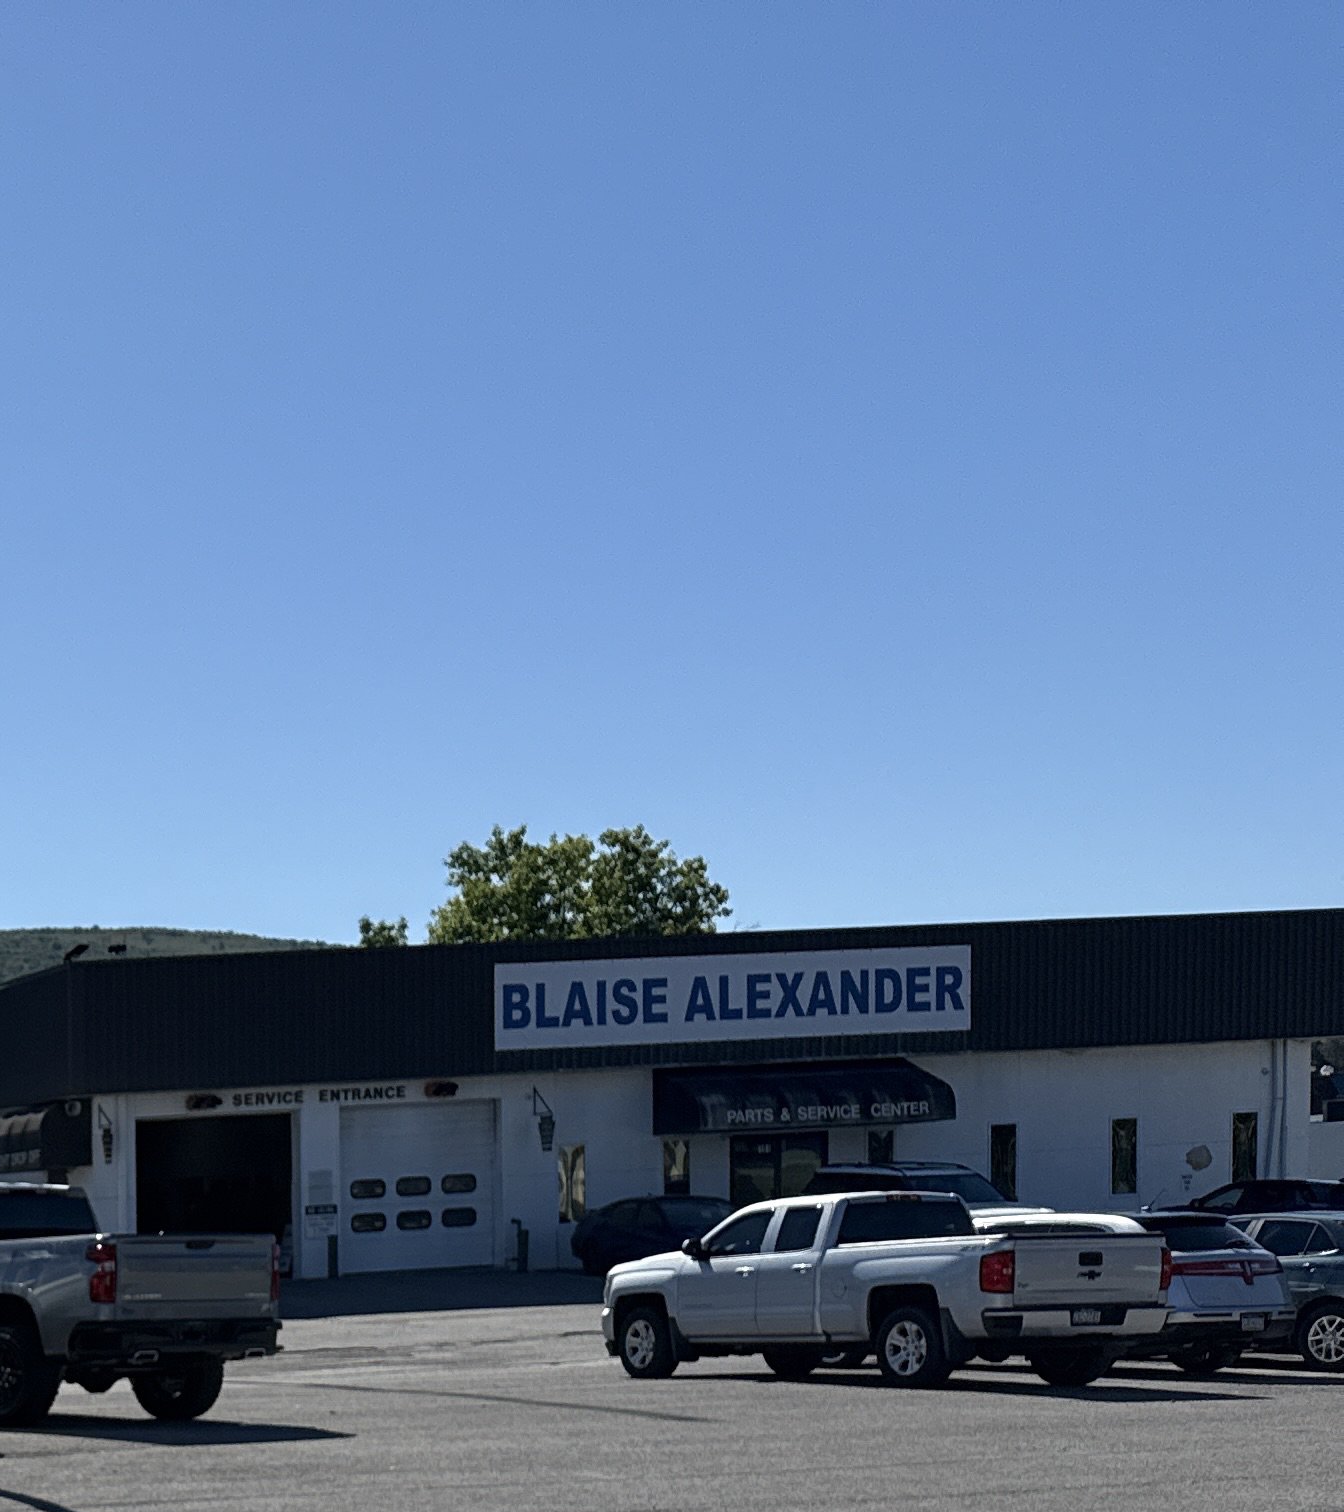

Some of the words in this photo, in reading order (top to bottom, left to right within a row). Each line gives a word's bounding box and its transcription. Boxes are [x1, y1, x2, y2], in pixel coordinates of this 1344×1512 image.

[501, 977, 669, 1030] BLAISE
[683, 965, 966, 1022] ALEXANDER
[231, 1089, 304, 1107] SERVICE
[318, 1085, 407, 1103] ENTRANCE
[726, 1107, 775, 1124] PARTS
[780, 1107, 791, 1122] &
[797, 1103, 861, 1120] SERVICE
[870, 1100, 930, 1118] CENTER
